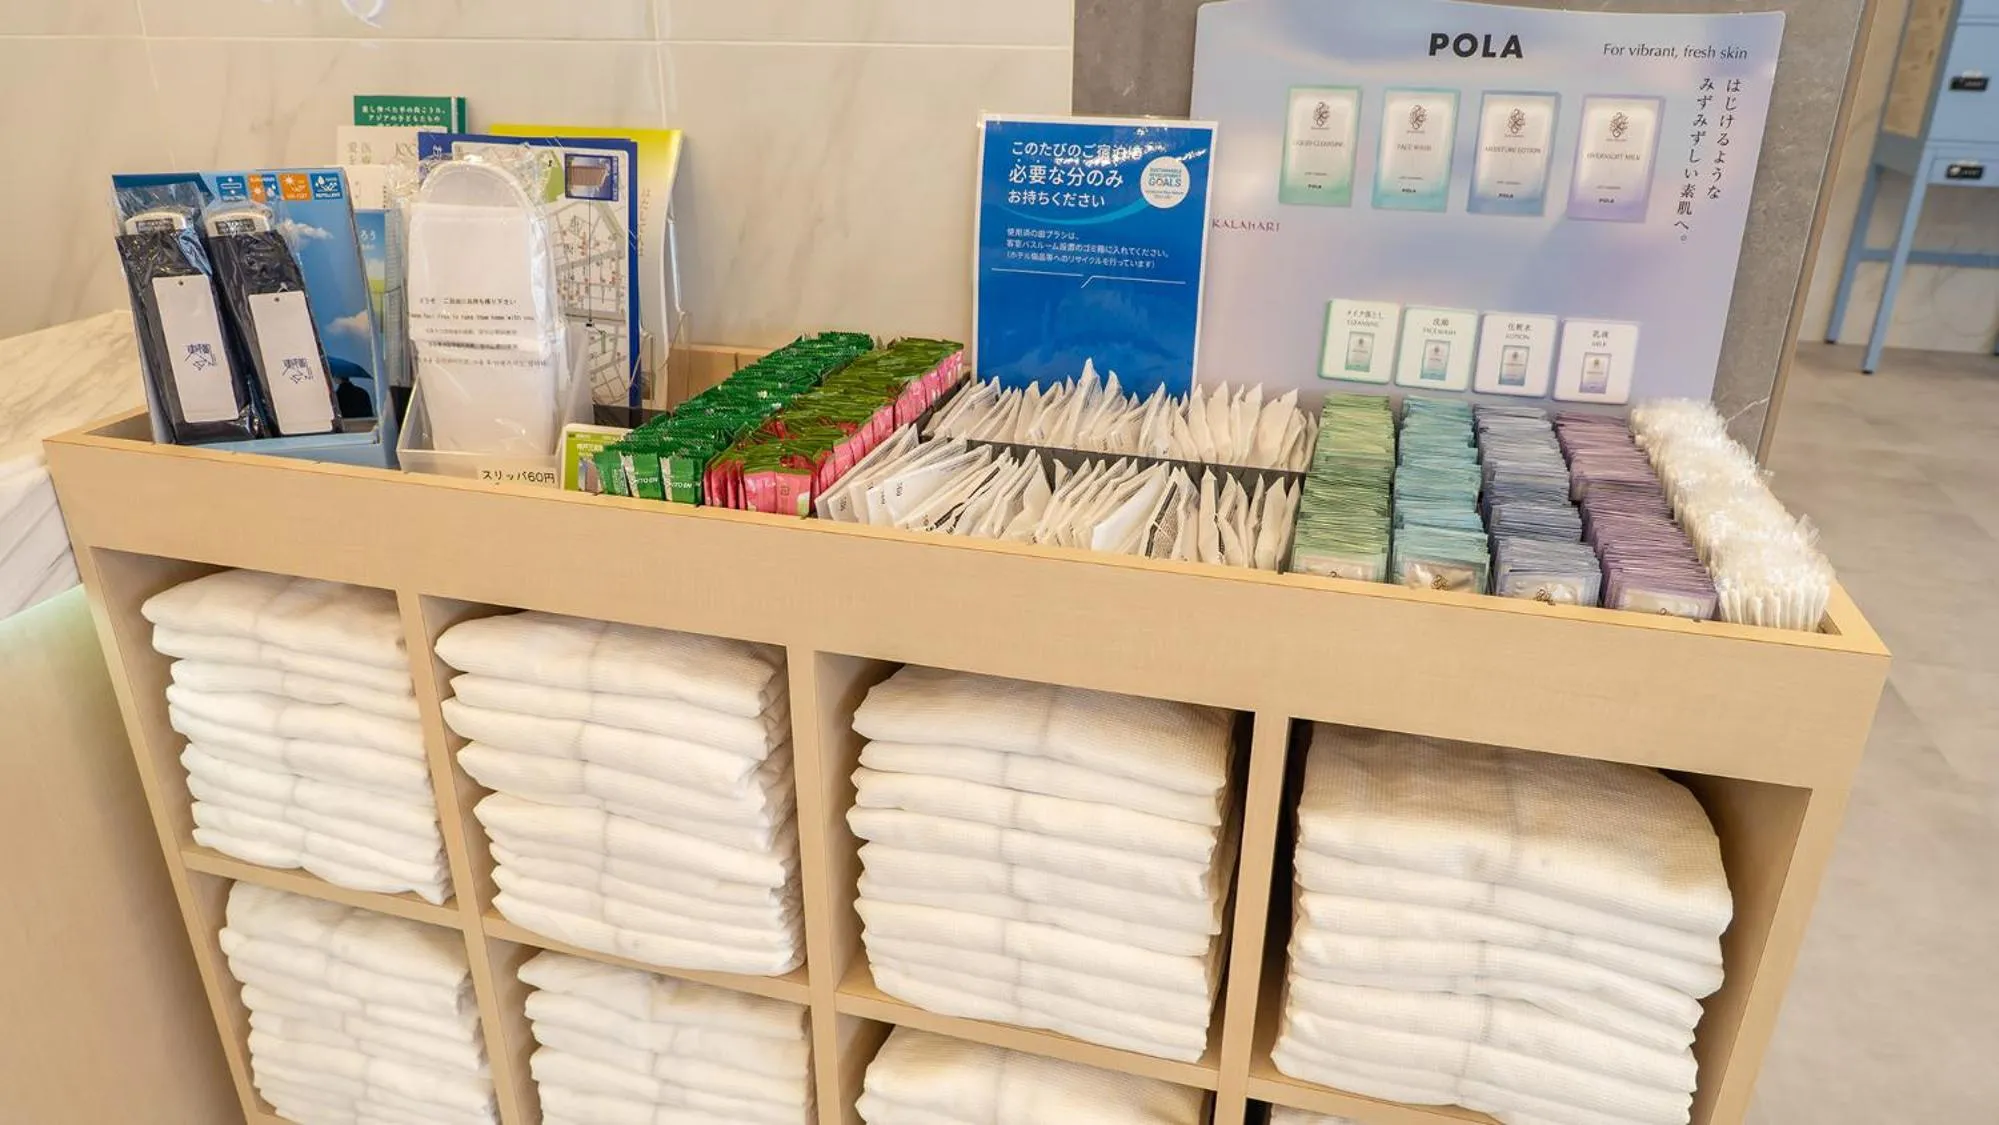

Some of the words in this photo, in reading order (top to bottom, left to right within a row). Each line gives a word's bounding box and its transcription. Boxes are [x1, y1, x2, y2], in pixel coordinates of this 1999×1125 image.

[1428, 32, 1524, 60] POLA
[1603, 43, 1625, 56] For
[1628, 43, 1678, 59] vibrant,
[1684, 44, 1715, 59] fresh
[1720, 46, 1748, 60] skin
[1707, 78, 1742, 200] はじけるような
[1674, 77, 1714, 242] みずみずしい素肌へ。
[1008, 163, 1124, 189] 必要な分のみ
[1148, 177, 1181, 187] GOALS
[1008, 189, 1105, 209] お持ちください
[1507, 322, 1532, 332] 化粧水
[482, 469, 556, 484] スリッパ60円
